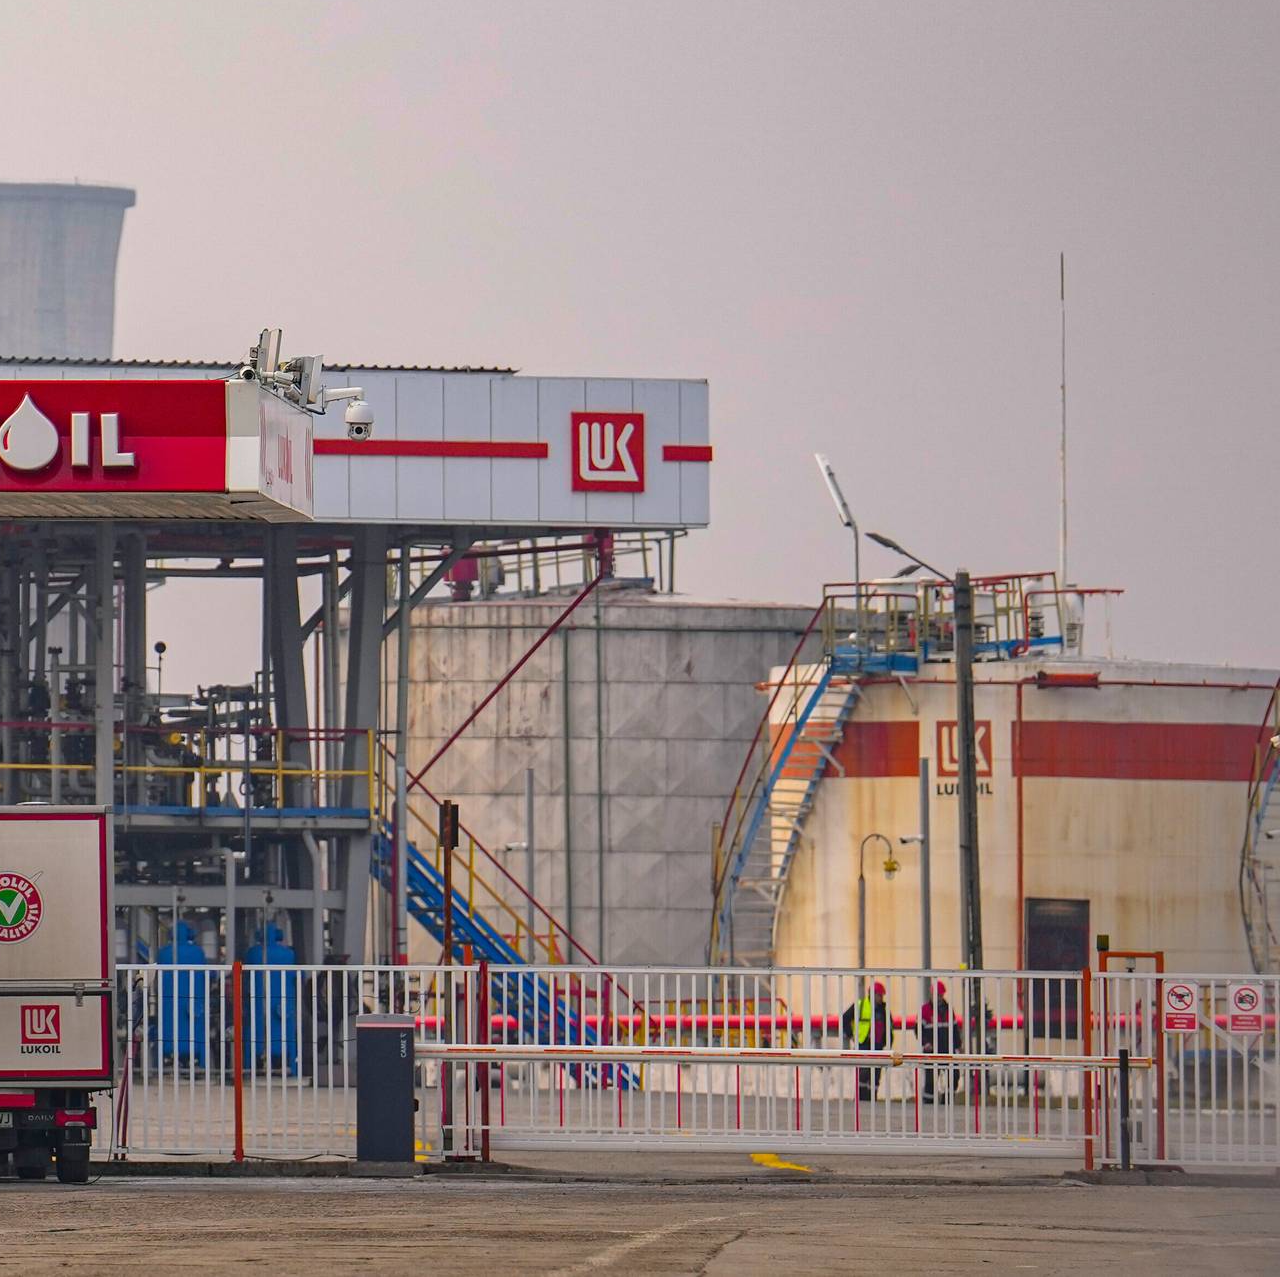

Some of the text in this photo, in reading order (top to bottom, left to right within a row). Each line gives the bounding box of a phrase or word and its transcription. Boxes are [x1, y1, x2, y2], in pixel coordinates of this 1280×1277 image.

[578, 421, 639, 481] LUK
[936, 782, 993, 795] LUIL
[24, 1008, 58, 1040] LUK
[20, 1045, 61, 1054] LUKOIL
